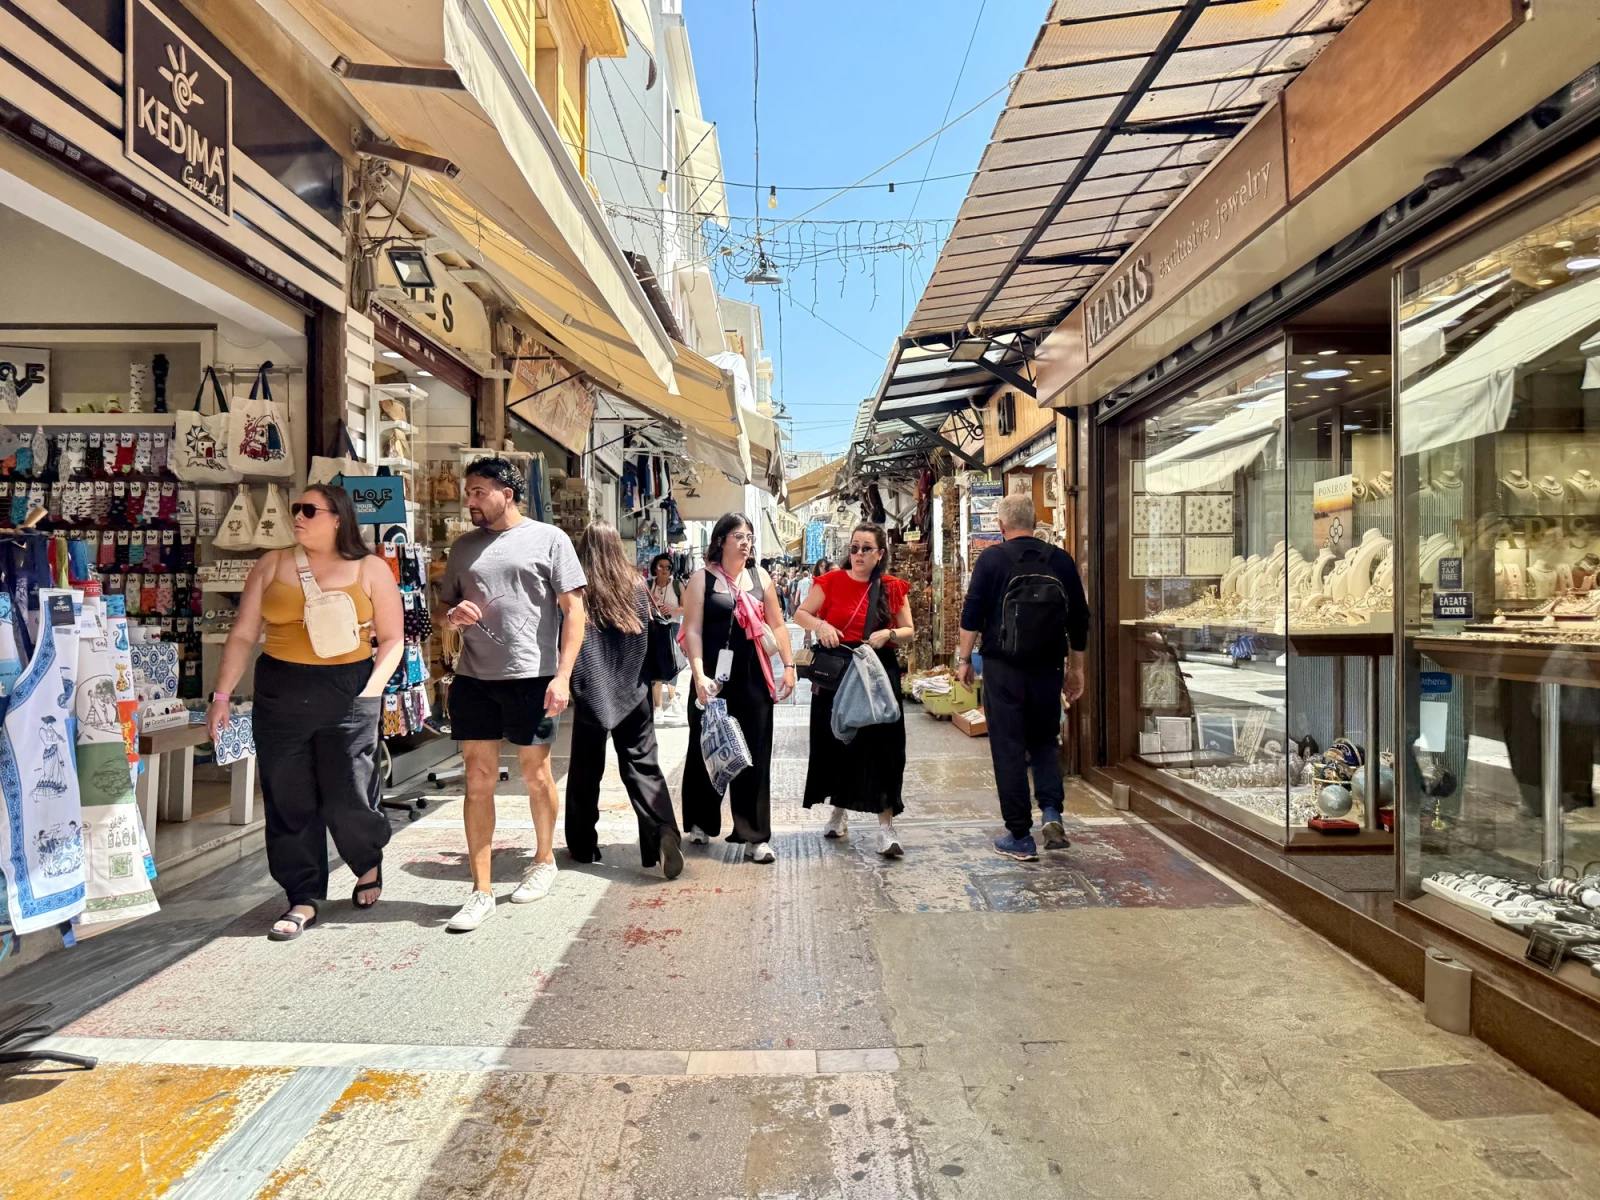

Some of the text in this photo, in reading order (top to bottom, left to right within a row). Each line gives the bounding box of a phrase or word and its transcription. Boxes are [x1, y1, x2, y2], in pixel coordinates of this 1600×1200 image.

[137, 86, 225, 186] KEDIMA
[181, 165, 224, 207] Greek Art
[1085, 161, 1271, 348] MARIS exclusive jewelry
[353, 489, 393, 509] LOVE
[1318, 482, 1347, 496] PONIROS
